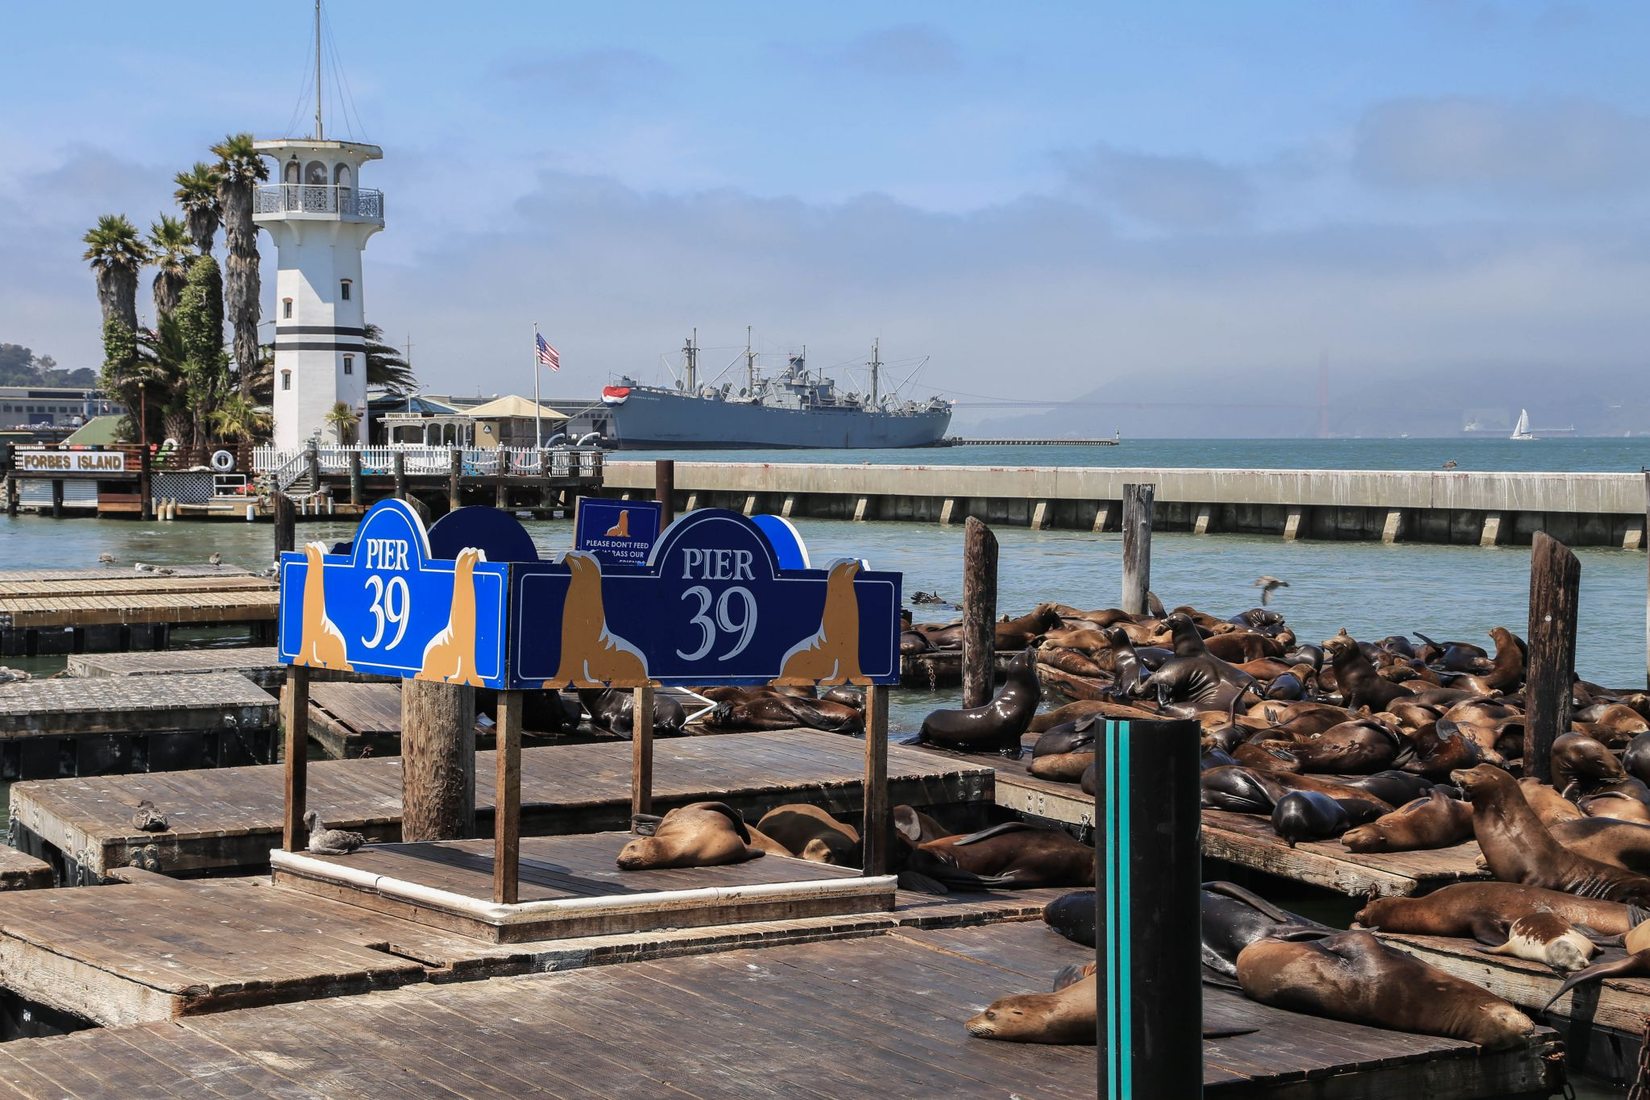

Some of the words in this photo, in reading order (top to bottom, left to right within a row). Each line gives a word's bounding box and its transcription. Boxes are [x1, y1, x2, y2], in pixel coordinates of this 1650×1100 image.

[24, 455, 71, 469] FORBES
[78, 455, 122, 469] ISLAND
[366, 538, 410, 571] PIER
[586, 539, 610, 547] PLEASE
[681, 547, 756, 581] PIER
[361, 575, 411, 651] 39
[676, 585, 758, 661] 39
